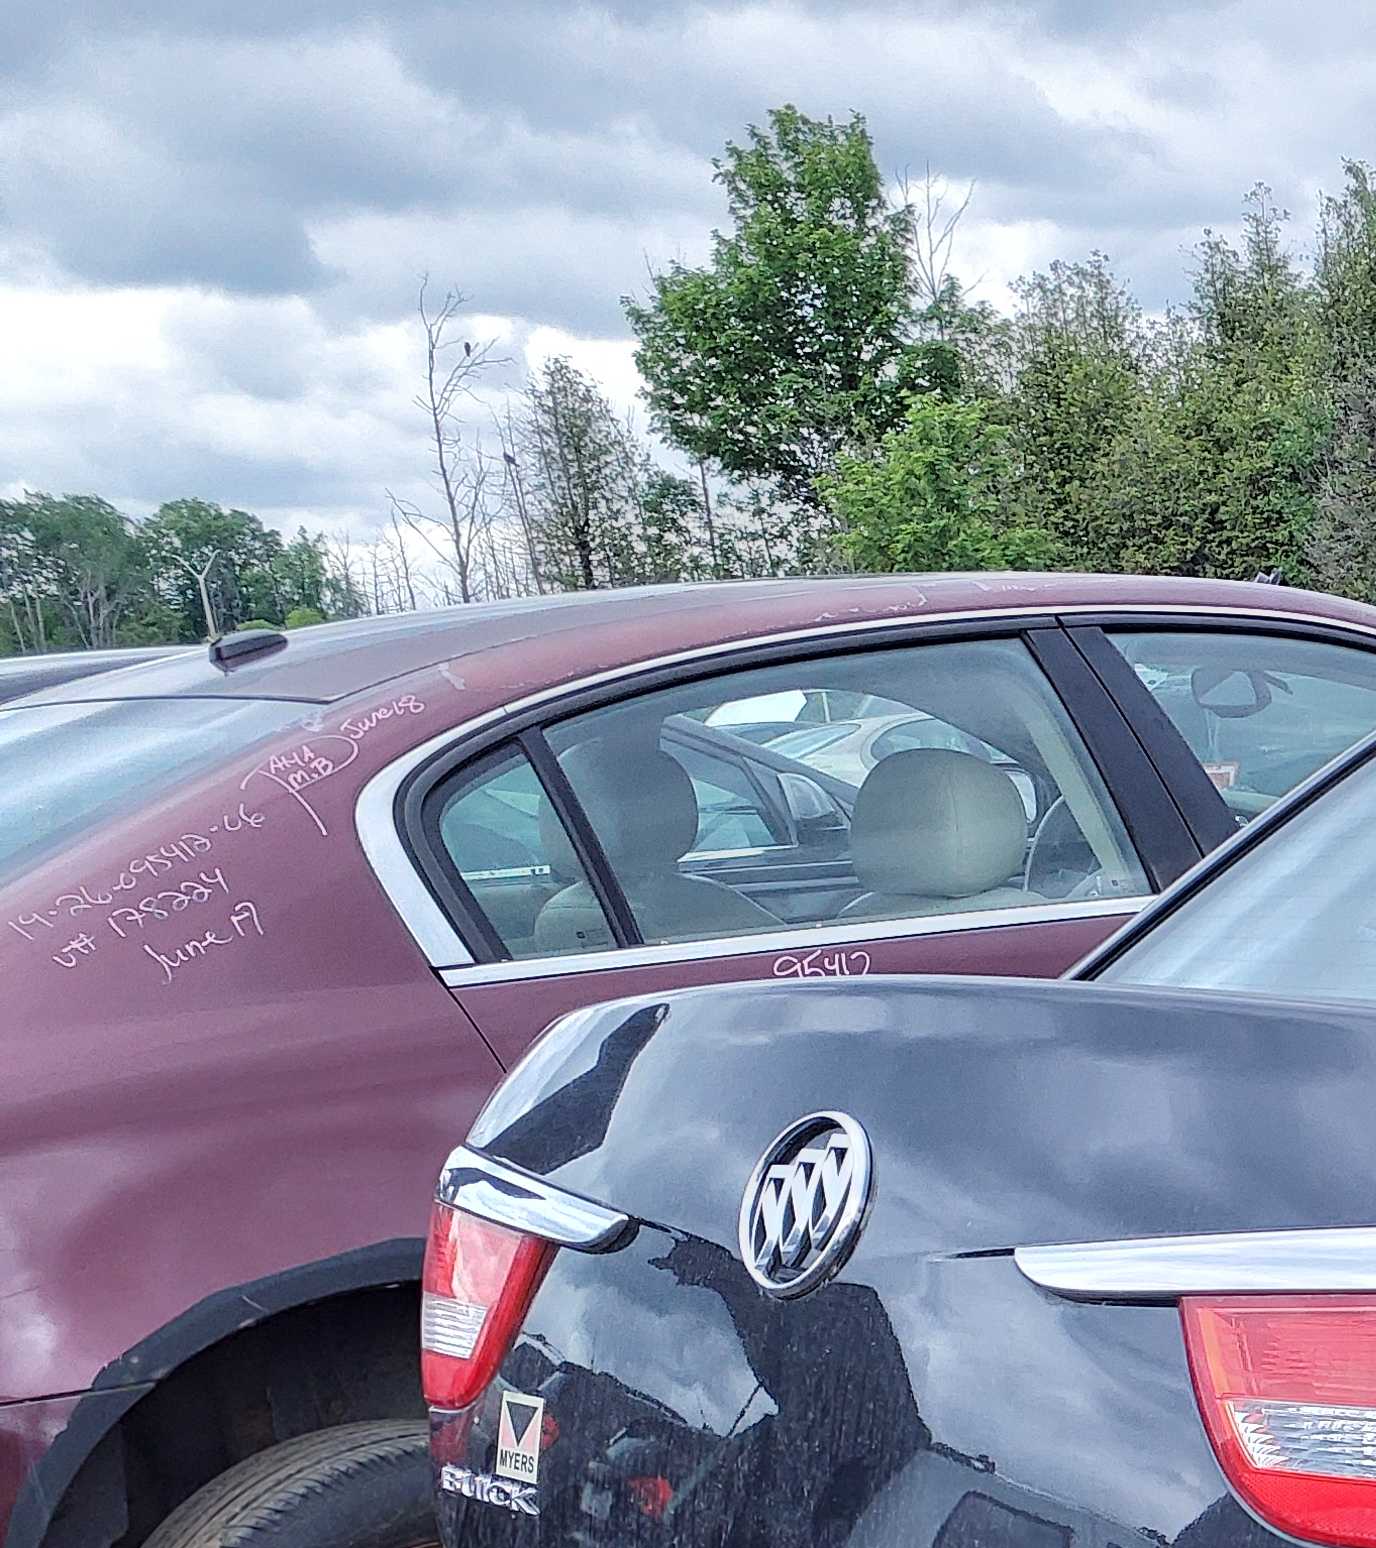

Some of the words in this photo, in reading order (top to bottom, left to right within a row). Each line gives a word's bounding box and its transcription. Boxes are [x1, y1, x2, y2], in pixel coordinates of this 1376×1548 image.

[340, 707, 393, 739] June
[107, 867, 230, 938] 178224
[143, 929, 233, 984] June
[499, 1448, 535, 1474] MYERS
[440, 1463, 541, 1516] BUICK
